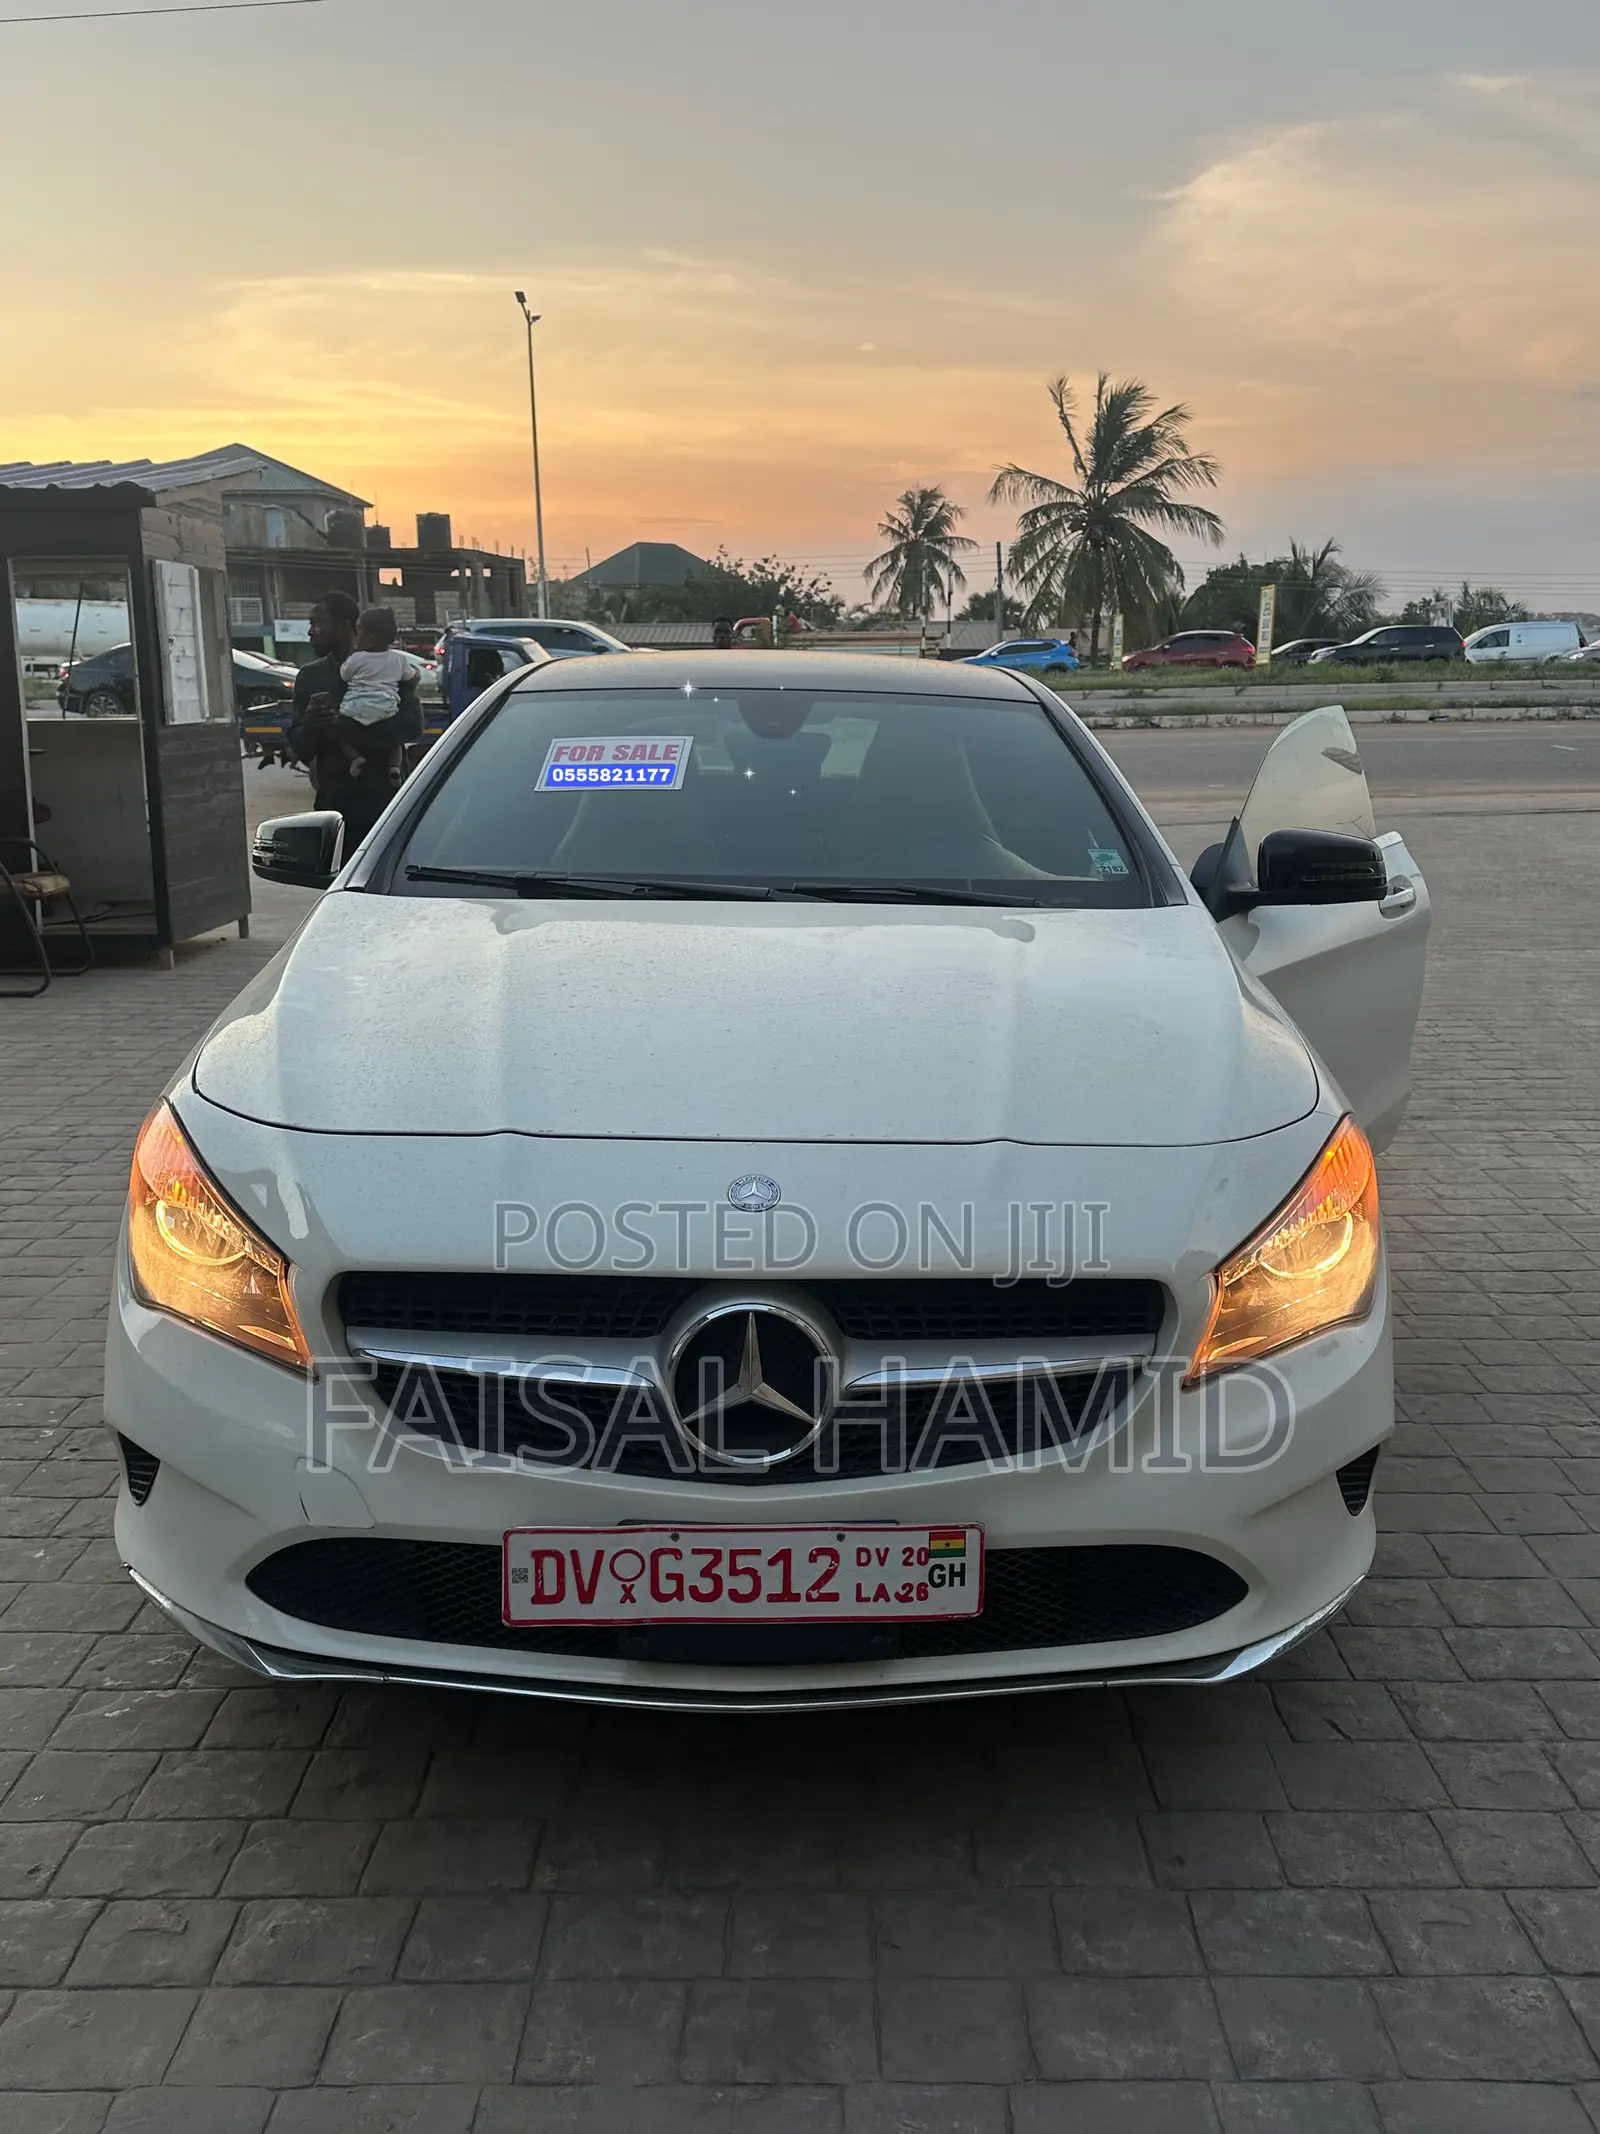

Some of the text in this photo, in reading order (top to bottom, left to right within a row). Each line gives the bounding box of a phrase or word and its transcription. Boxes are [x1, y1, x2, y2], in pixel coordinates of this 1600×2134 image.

[552, 744, 680, 762] FOR SALE
[856, 1546, 930, 1567] DV 20
[530, 1547, 841, 1605] DV G3512
[928, 1562, 966, 1589] GH
[855, 1582, 891, 1603] LA
